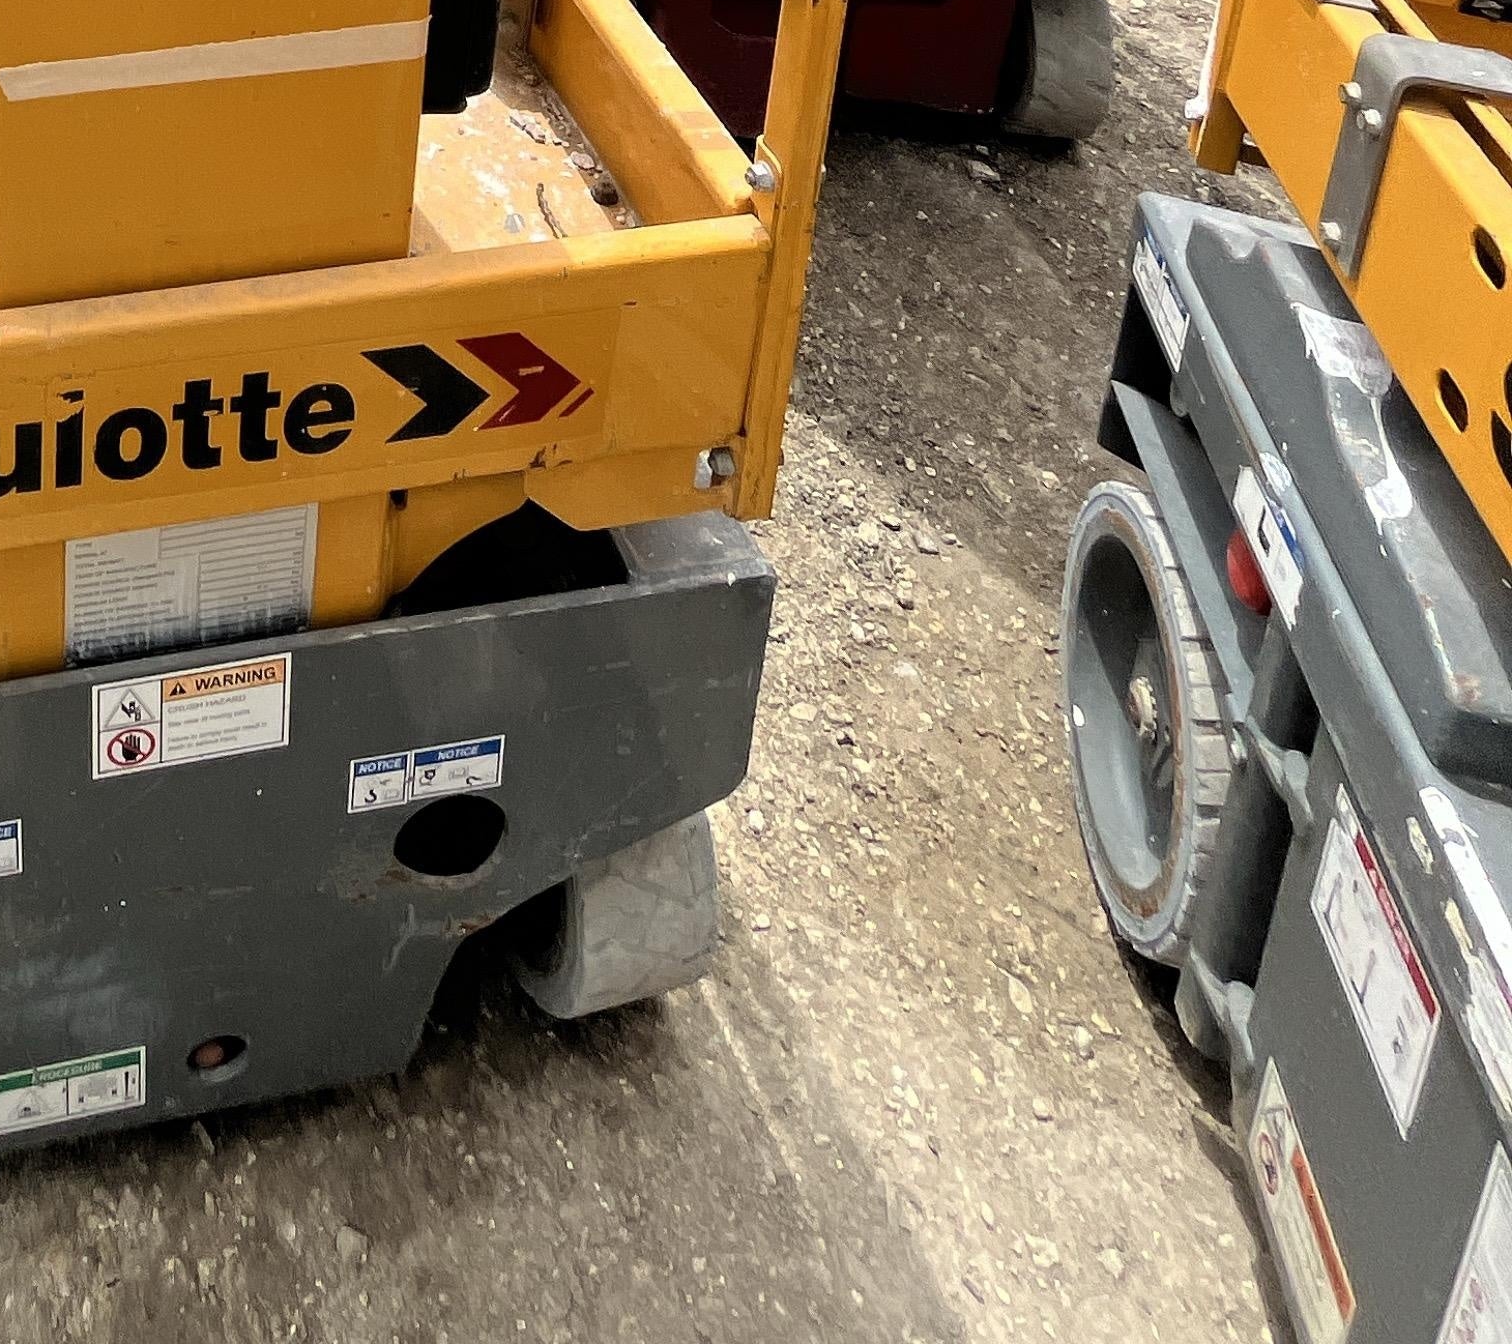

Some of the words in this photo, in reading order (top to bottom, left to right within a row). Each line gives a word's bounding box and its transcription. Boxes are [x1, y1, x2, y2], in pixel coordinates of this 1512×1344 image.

[194, 666, 276, 691] WARNING
[437, 745, 480, 761] NOTICE
[357, 758, 402, 774] NOTICE
